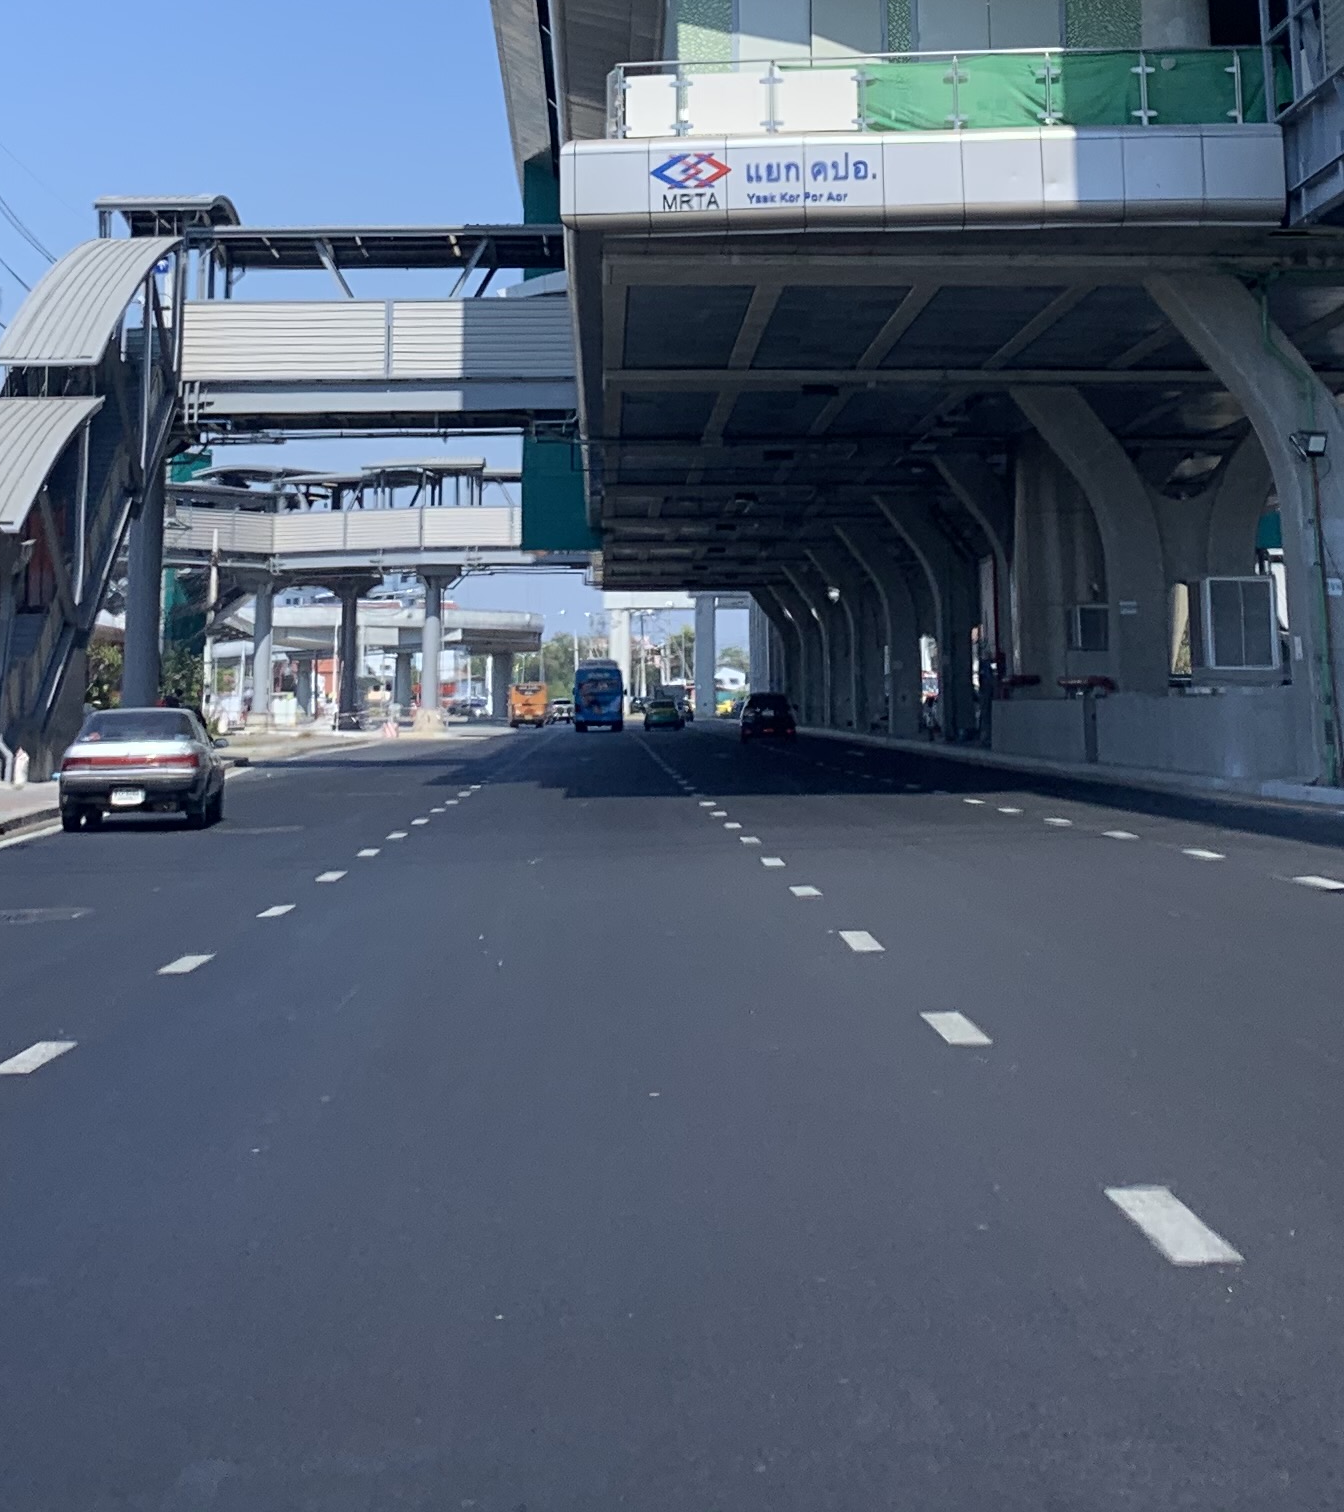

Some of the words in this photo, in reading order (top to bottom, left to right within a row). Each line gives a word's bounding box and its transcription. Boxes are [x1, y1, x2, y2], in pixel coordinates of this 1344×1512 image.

[746, 161, 800, 184] แยก
[811, 152, 877, 182] คปอ.
[662, 192, 720, 211] MRTA
[780, 192, 800, 203] Kor
[804, 191, 824, 202] Por
[827, 191, 848, 202] Aor
